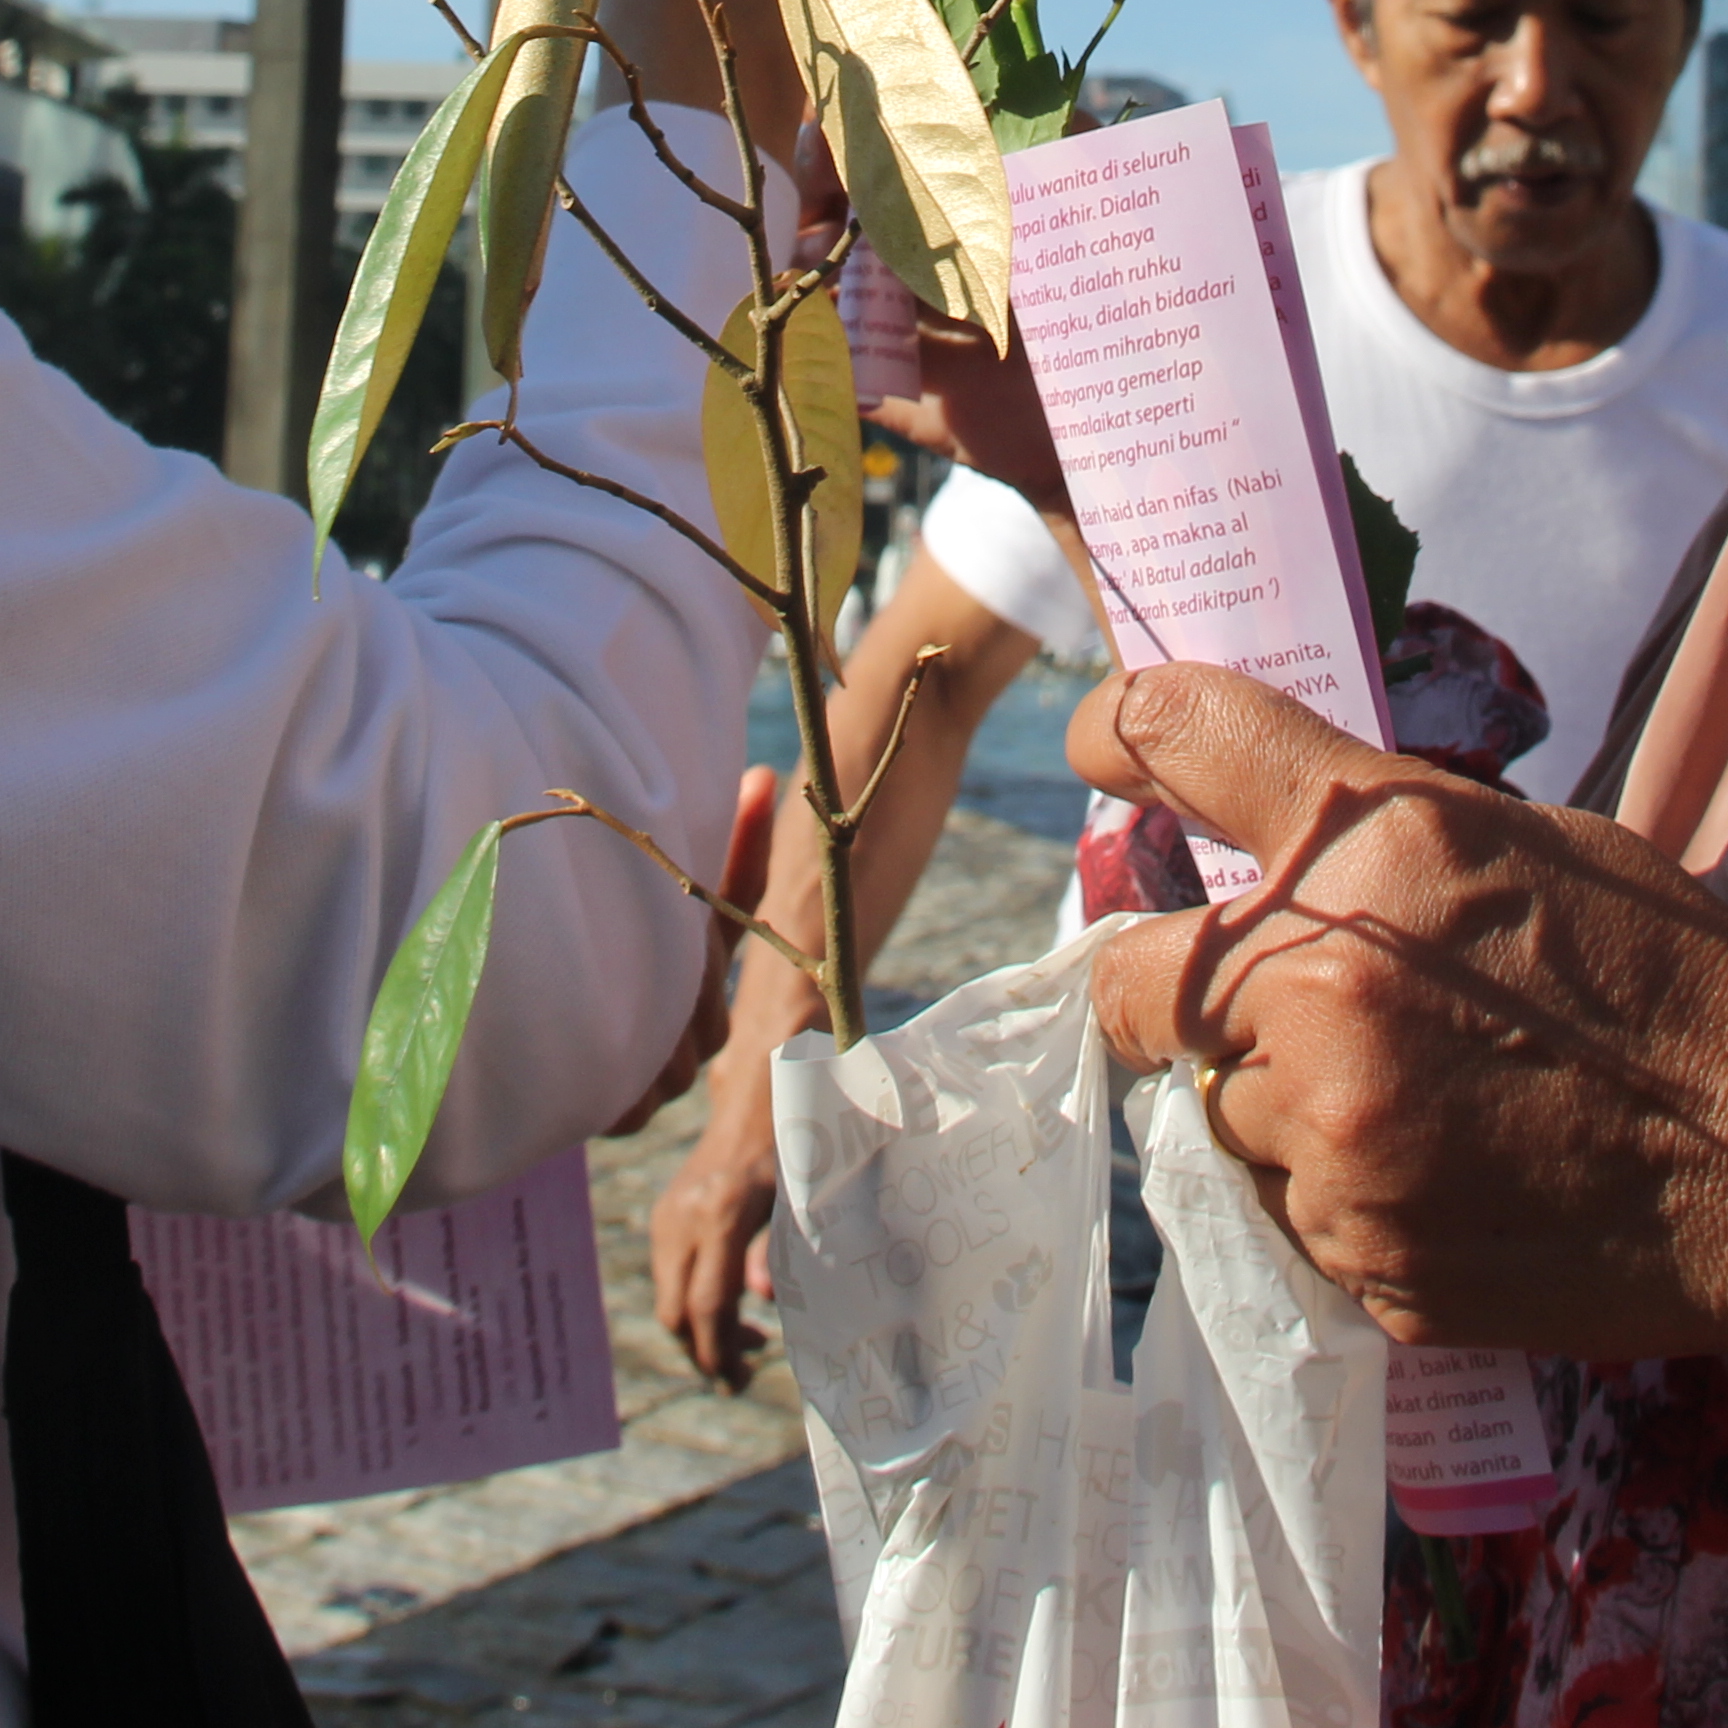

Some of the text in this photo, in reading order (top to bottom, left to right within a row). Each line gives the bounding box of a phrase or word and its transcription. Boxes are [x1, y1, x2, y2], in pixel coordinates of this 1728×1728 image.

[1038, 169, 1098, 197] wanita
[1102, 159, 1119, 181] di
[1122, 142, 1191, 177] seluruh
[1049, 204, 1097, 232] akhir.
[1100, 186, 1160, 219] Dialah
[1035, 239, 1086, 270] dialah
[1090, 225, 1155, 256] cahaya
[1021, 283, 1067, 308] hatiku,
[1070, 266, 1124, 297] dialah
[1128, 256, 1182, 283] ruhku
[1096, 296, 1152, 327] dialah
[1156, 276, 1235, 307] bidadari
[1053, 346, 1100, 372] dalam
[1103, 323, 1201, 361] mihrabnya
[1045, 358, 1203, 409] cahayanya gemerlap
[1069, 410, 1133, 439] malaikat
[1135, 393, 1196, 427] seperti
[1098, 430, 1176, 472] penghuni
[1179, 422, 1228, 450] bumi
[1101, 498, 1134, 523] haid
[1136, 495, 1170, 517] dan
[1173, 485, 1219, 510] nifas
[1227, 468, 1284, 501] (Nabi
[1131, 534, 1160, 557] apa
[1163, 521, 1226, 548] makna
[1231, 511, 1249, 533] al
[1146, 559, 1186, 586] Batul
[1189, 547, 1256, 578] adalah
[1171, 584, 1264, 618] sedikitpun
[1255, 643, 1331, 671] wanita,
[875, 1121, 1019, 1215] POWER
[849, 1190, 1010, 1299] TOOLS
[1418, 1353, 1463, 1377] baik
[1468, 1350, 1497, 1369] itu
[1427, 1386, 1505, 1411] dimana
[1448, 1420, 1514, 1443] dalam
[1450, 1454, 1522, 1477] wanita
